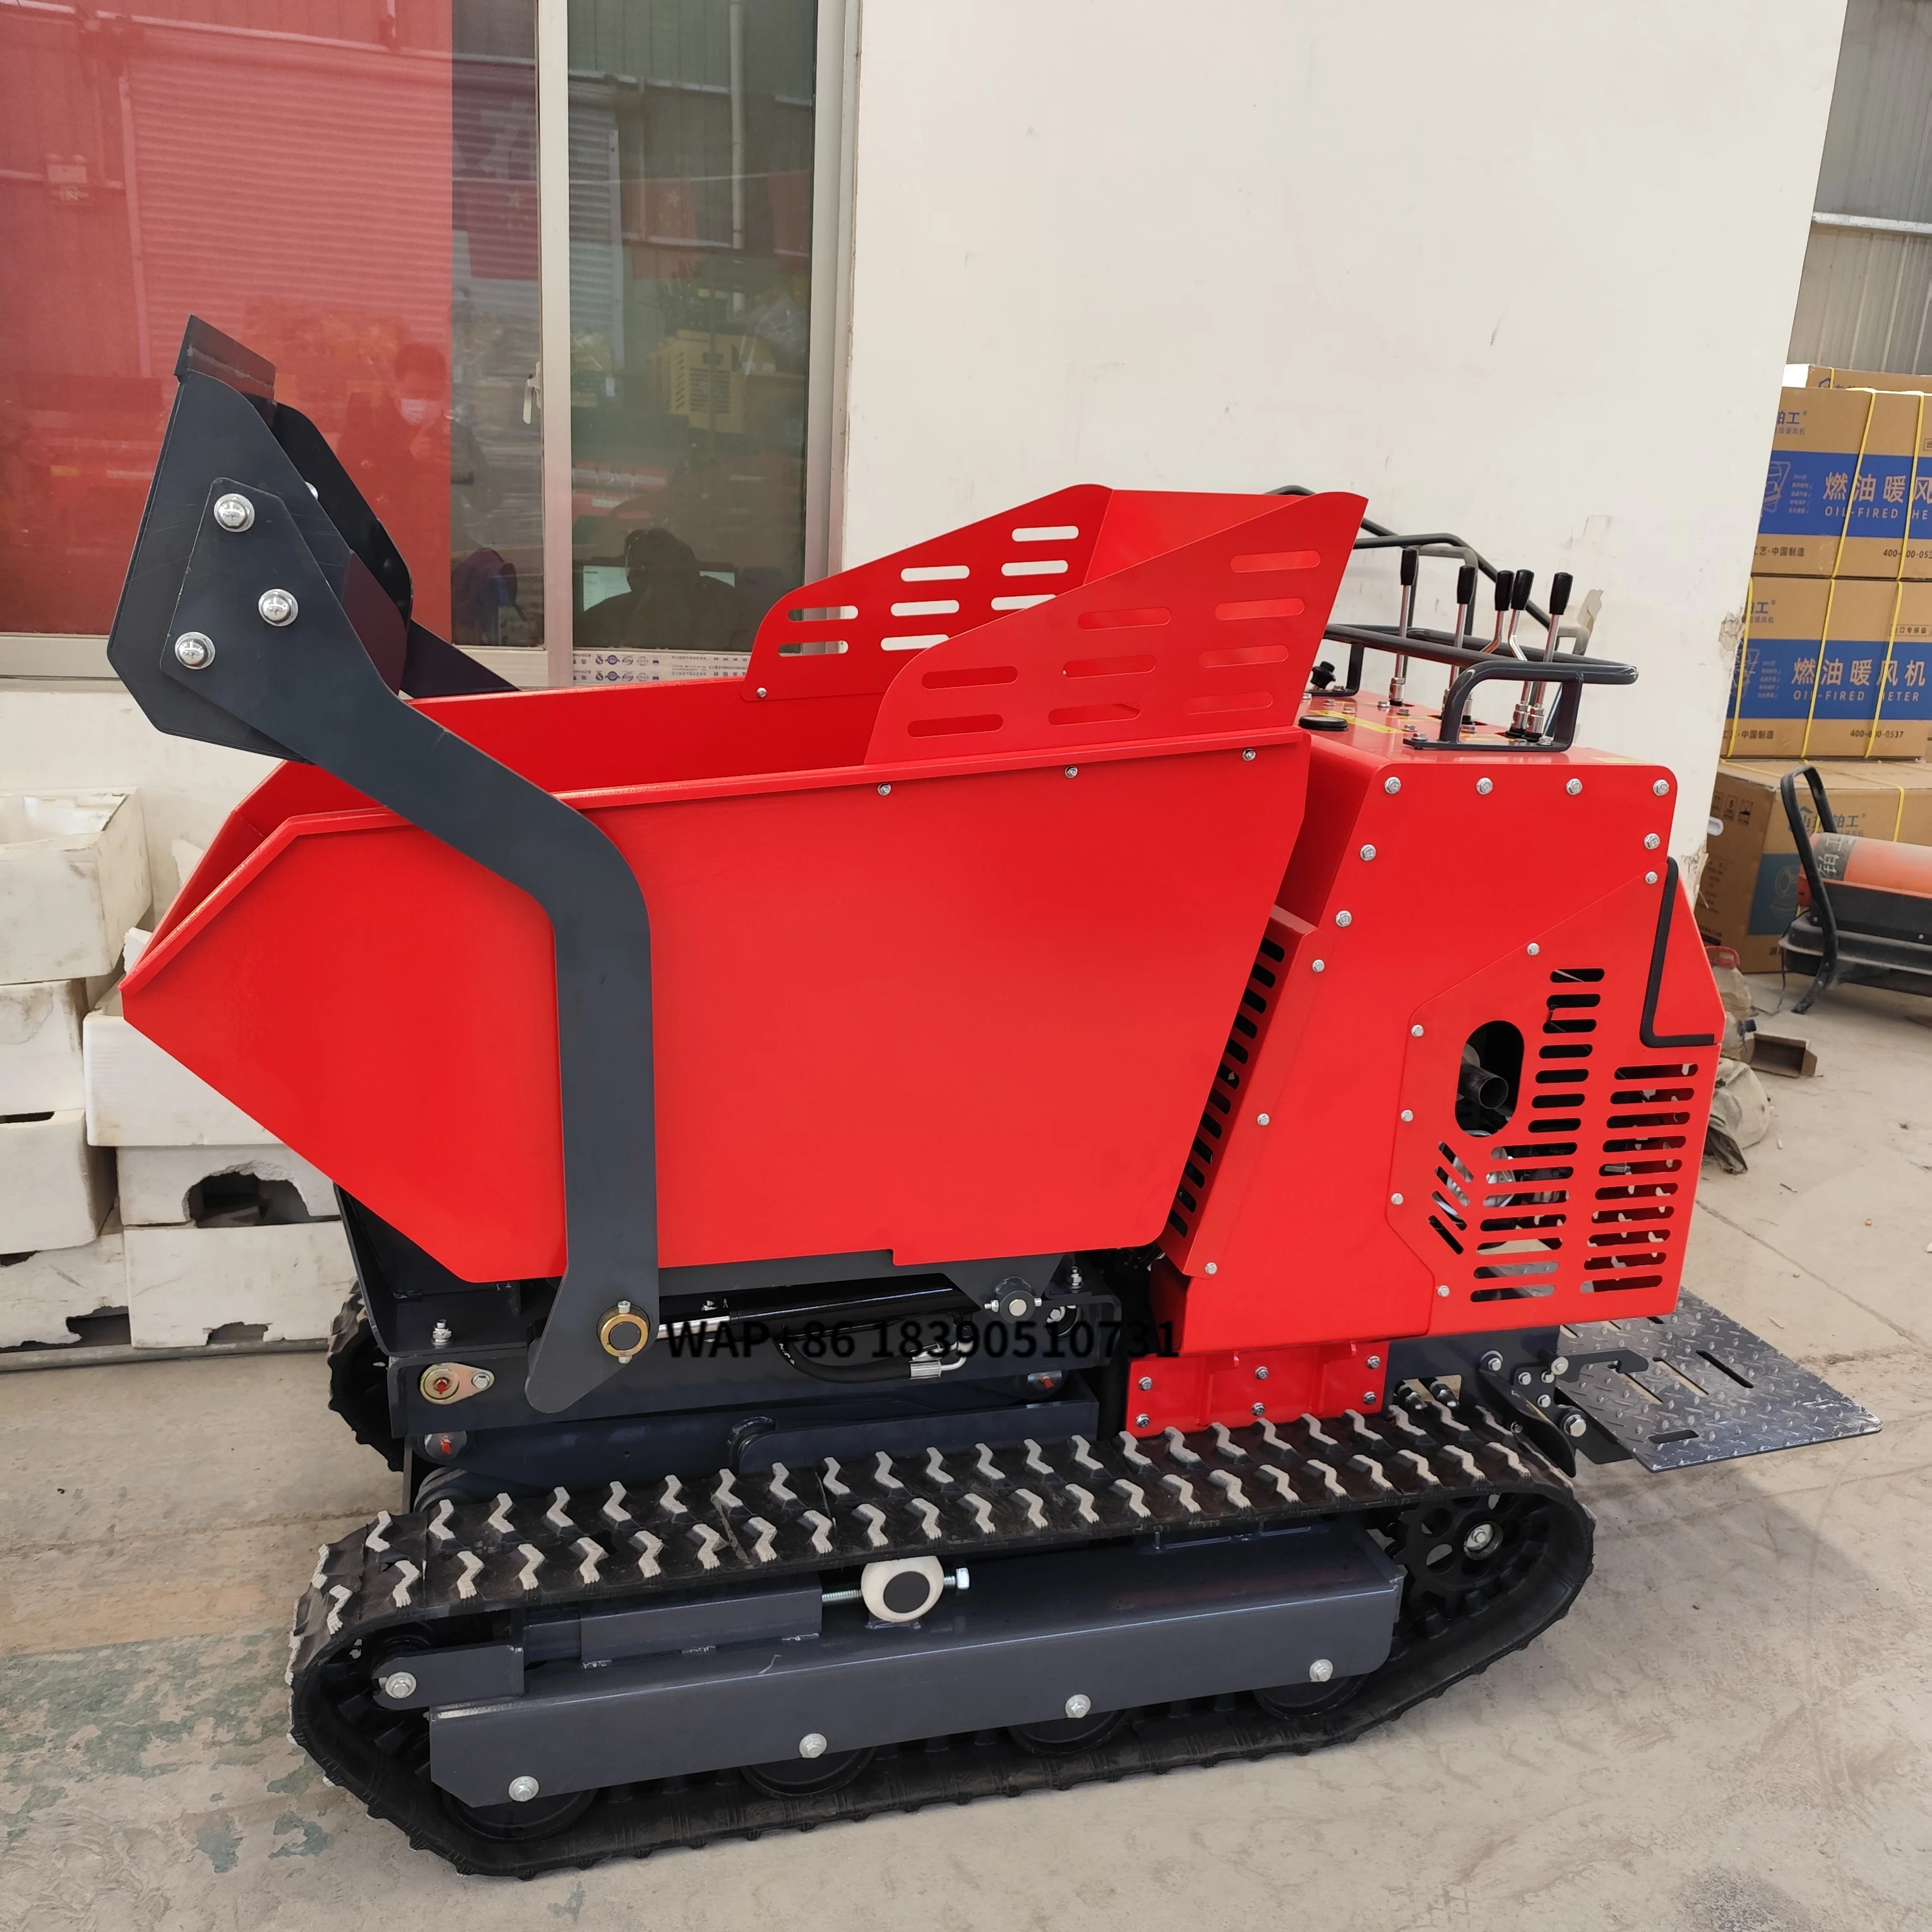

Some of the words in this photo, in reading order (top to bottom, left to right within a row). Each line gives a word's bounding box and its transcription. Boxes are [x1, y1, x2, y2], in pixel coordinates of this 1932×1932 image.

[1791, 657, 1926, 686] 燃油暖风机
[1793, 689, 1865, 702] OI-FIRED
